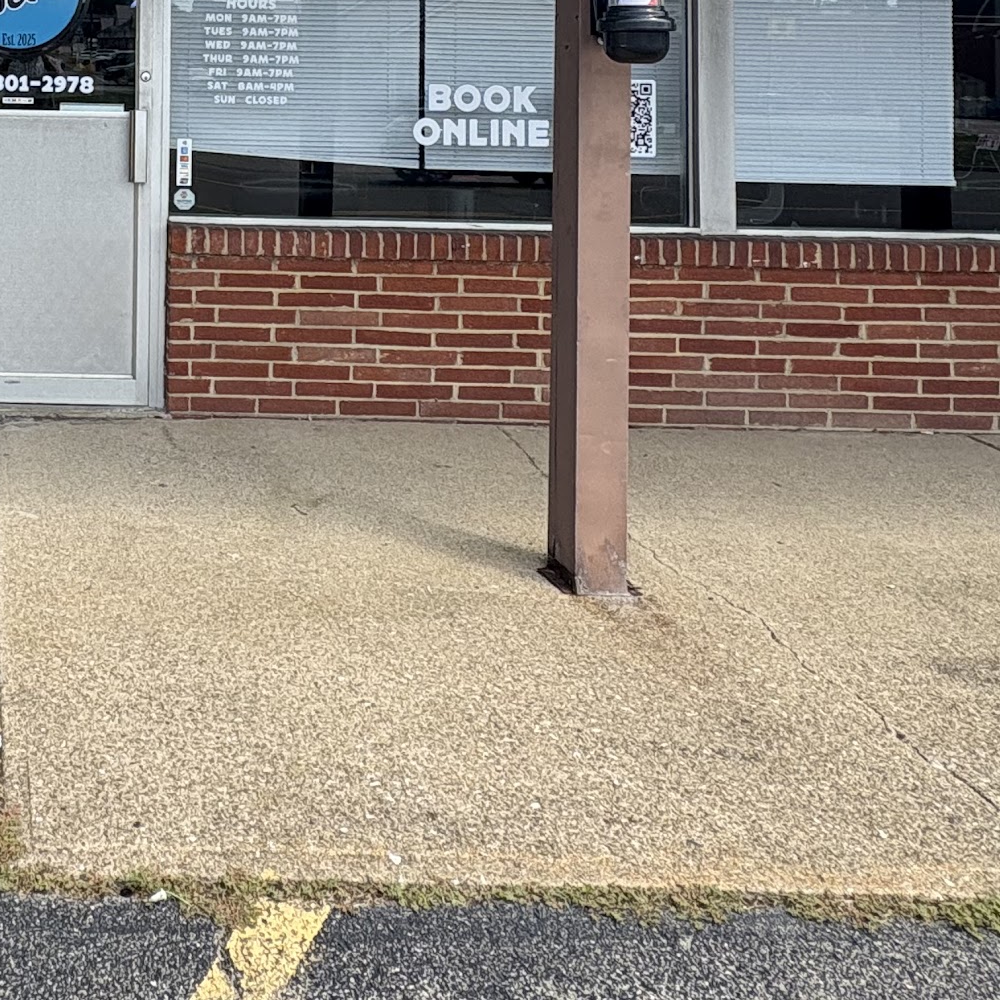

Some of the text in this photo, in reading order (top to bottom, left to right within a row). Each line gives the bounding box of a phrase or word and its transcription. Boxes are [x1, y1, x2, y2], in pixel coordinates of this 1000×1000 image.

[205, 14, 298, 23] MON 9AM-7PM
[204, 27, 298, 37] TUES 9AM-7PM
[17, 33, 36, 46] 2025
[205, 41, 298, 50] WED 9AM-7PM
[203, 54, 299, 64] THUR 9AM-7PM
[208, 68, 294, 77] FRI 9AM-7PM
[207, 82, 228, 90] SAT
[214, 96, 288, 104] SUN CLOSED
[428, 83, 537, 114] BOOK
[412, 117, 550, 148] ONLINE
